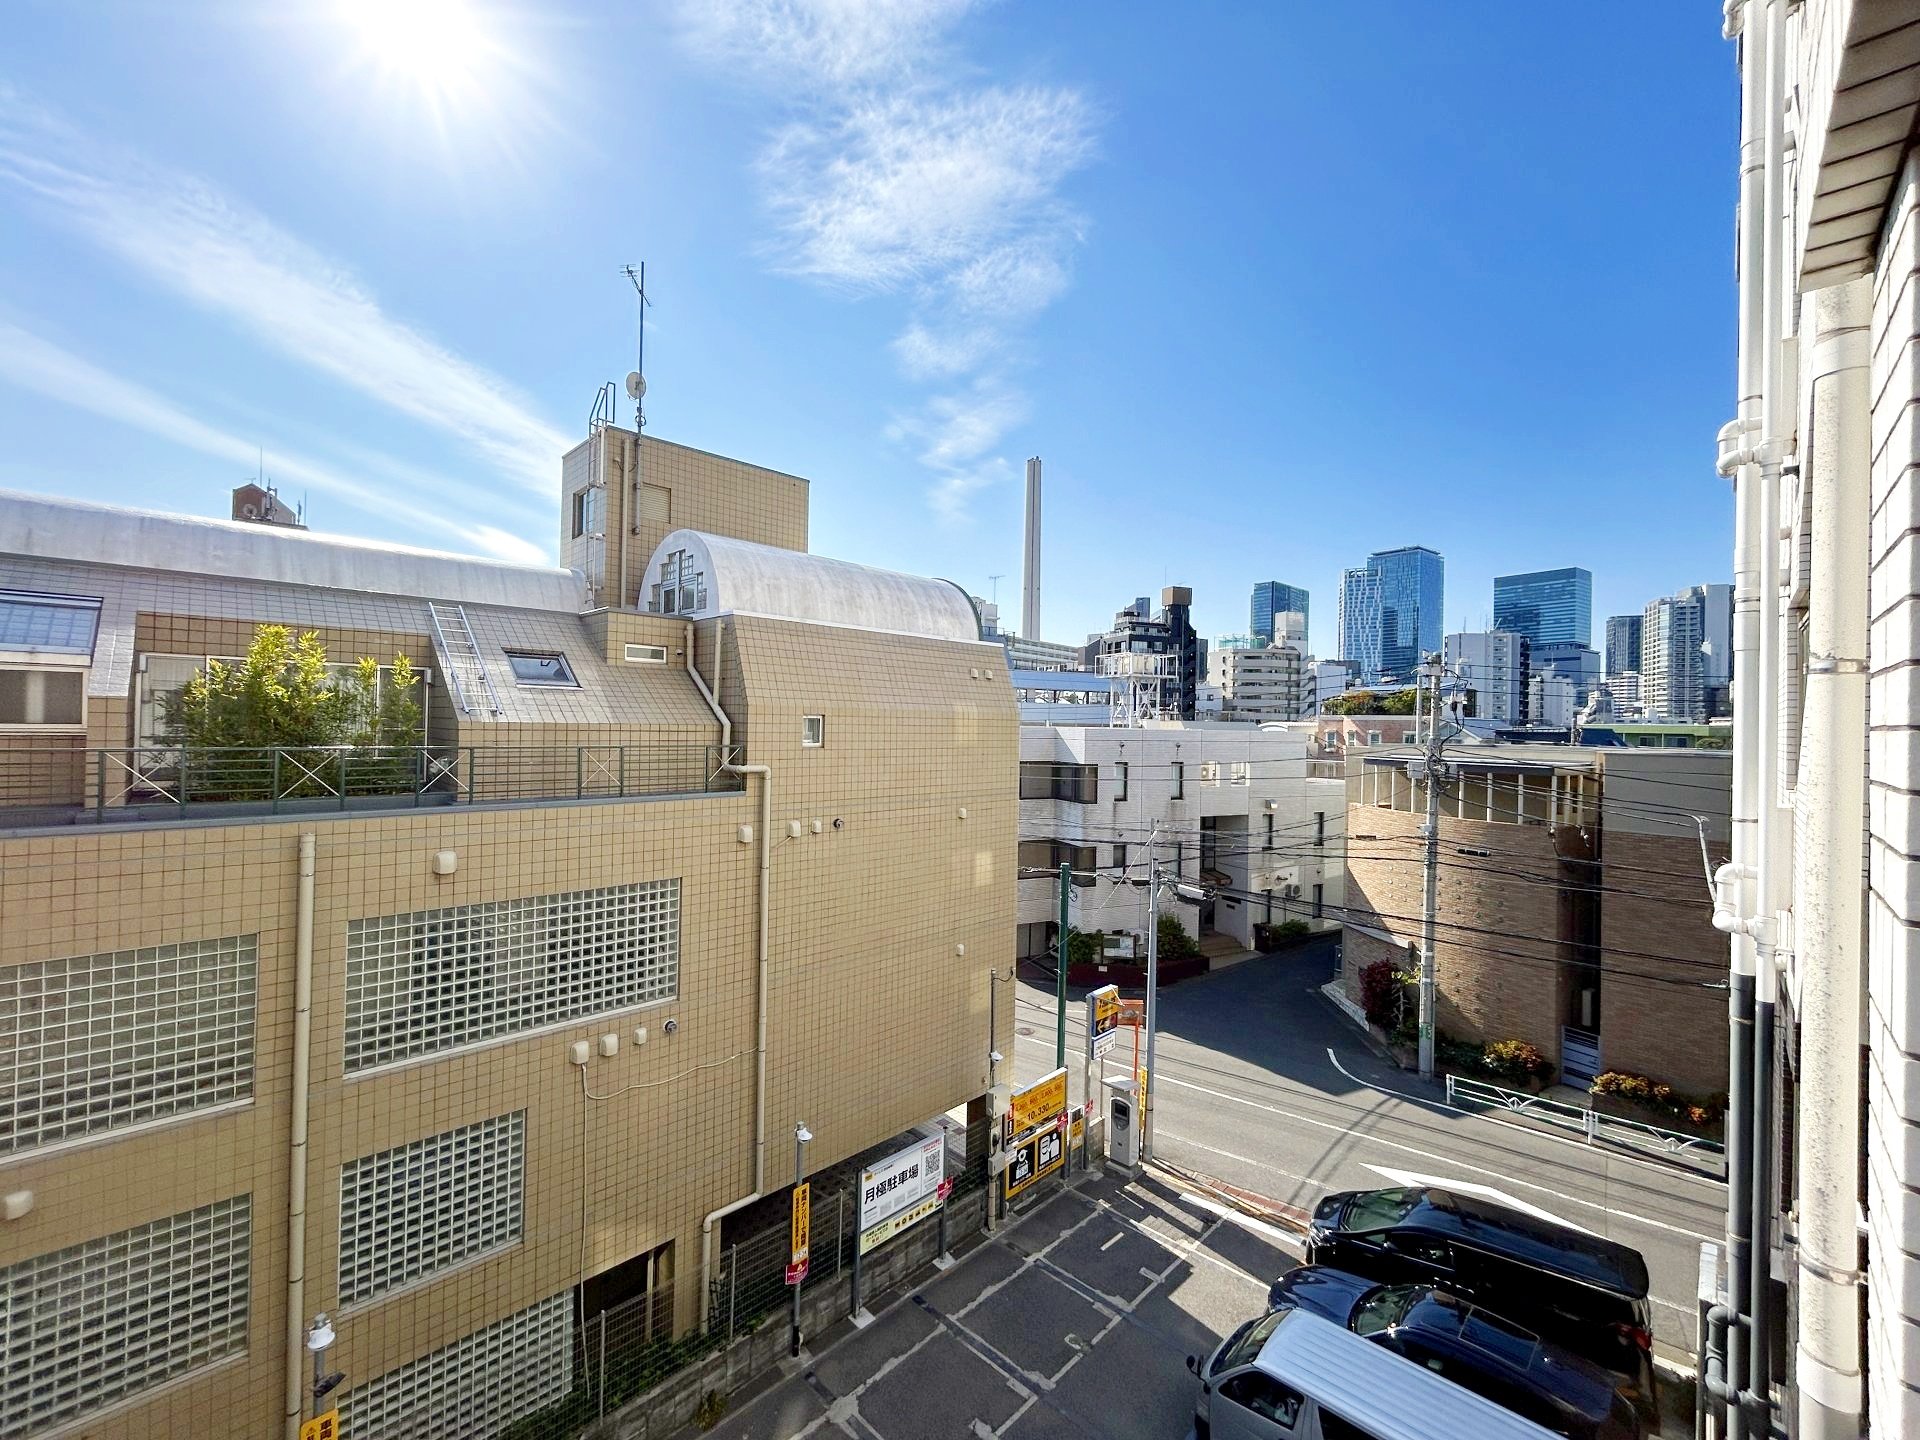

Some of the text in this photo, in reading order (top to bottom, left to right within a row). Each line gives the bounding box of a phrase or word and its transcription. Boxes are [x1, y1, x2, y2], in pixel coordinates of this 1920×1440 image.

[864, 1163, 919, 1204] 月極駐車場
